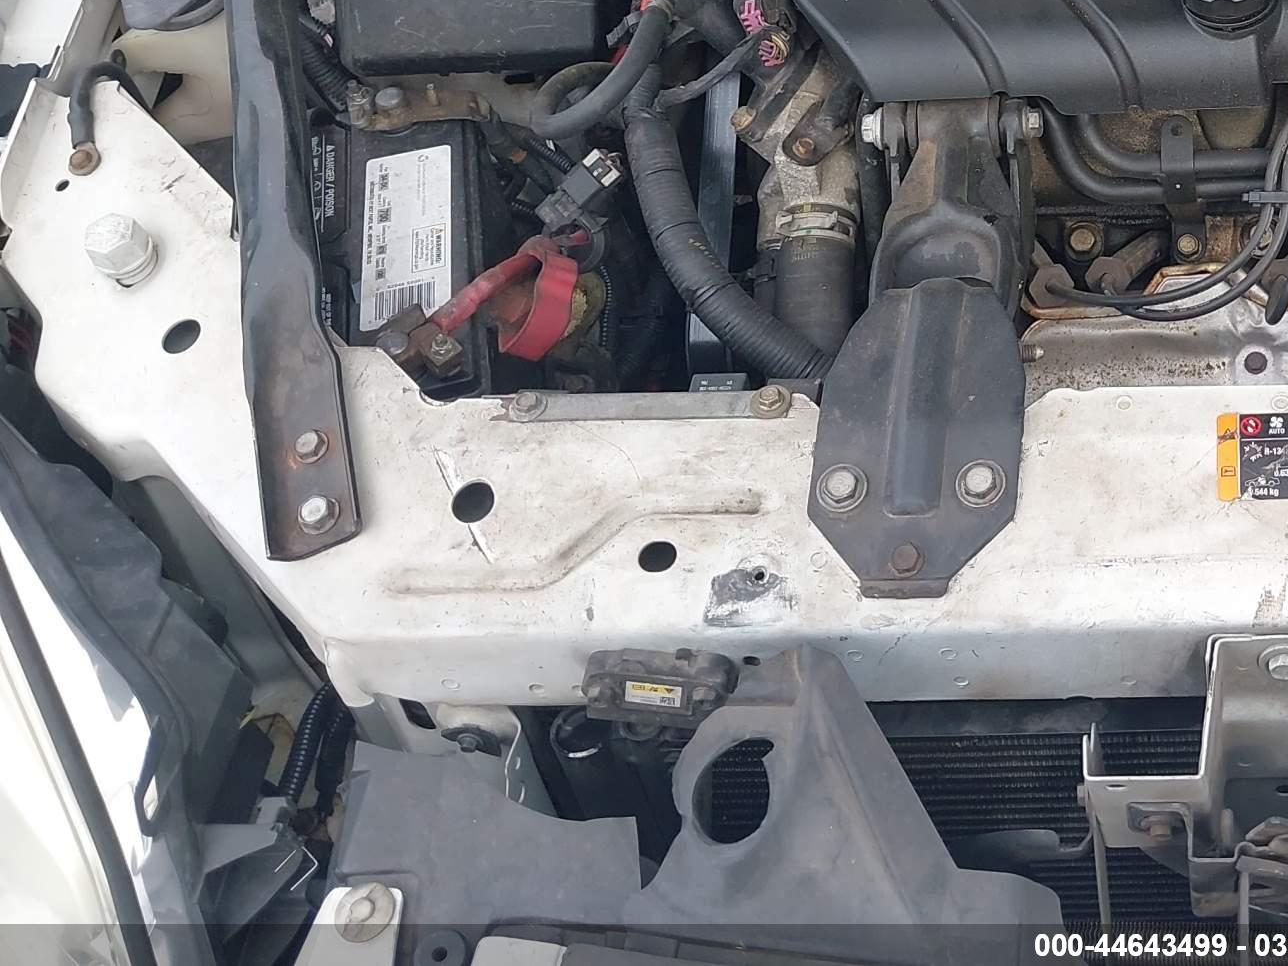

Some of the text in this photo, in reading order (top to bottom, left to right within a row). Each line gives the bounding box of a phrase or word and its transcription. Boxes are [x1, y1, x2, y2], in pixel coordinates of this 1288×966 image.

[325, 154, 335, 182] DANGER
[325, 188, 335, 218] POISON
[1269, 487, 1279, 496] kg
